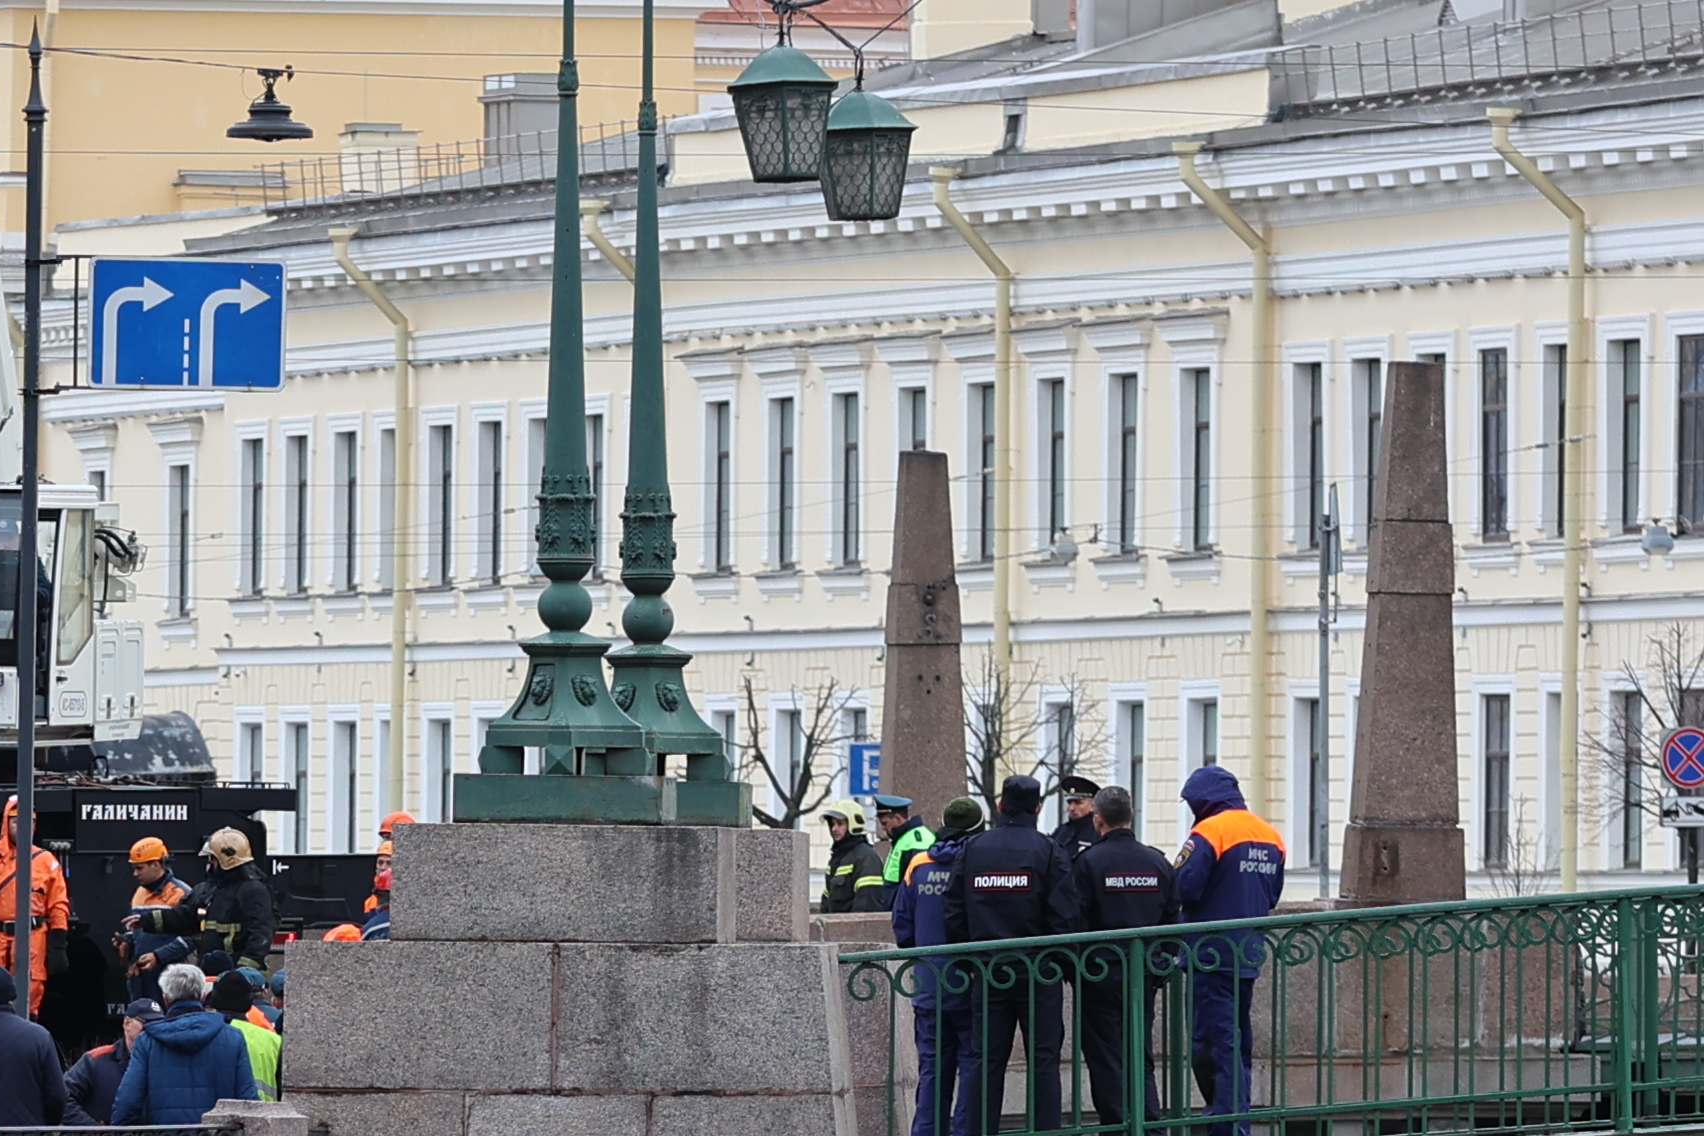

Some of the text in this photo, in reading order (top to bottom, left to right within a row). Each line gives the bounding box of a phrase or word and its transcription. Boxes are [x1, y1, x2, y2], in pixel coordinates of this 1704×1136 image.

[81, 804, 188, 820] ГАЛИЧАНИН
[1248, 848, 1268, 861] МЧС
[927, 871, 950, 882] МЧ
[974, 875, 1028, 888] ПОЛИЦИЯ
[1105, 876, 1158, 888] МВД РОССИИ
